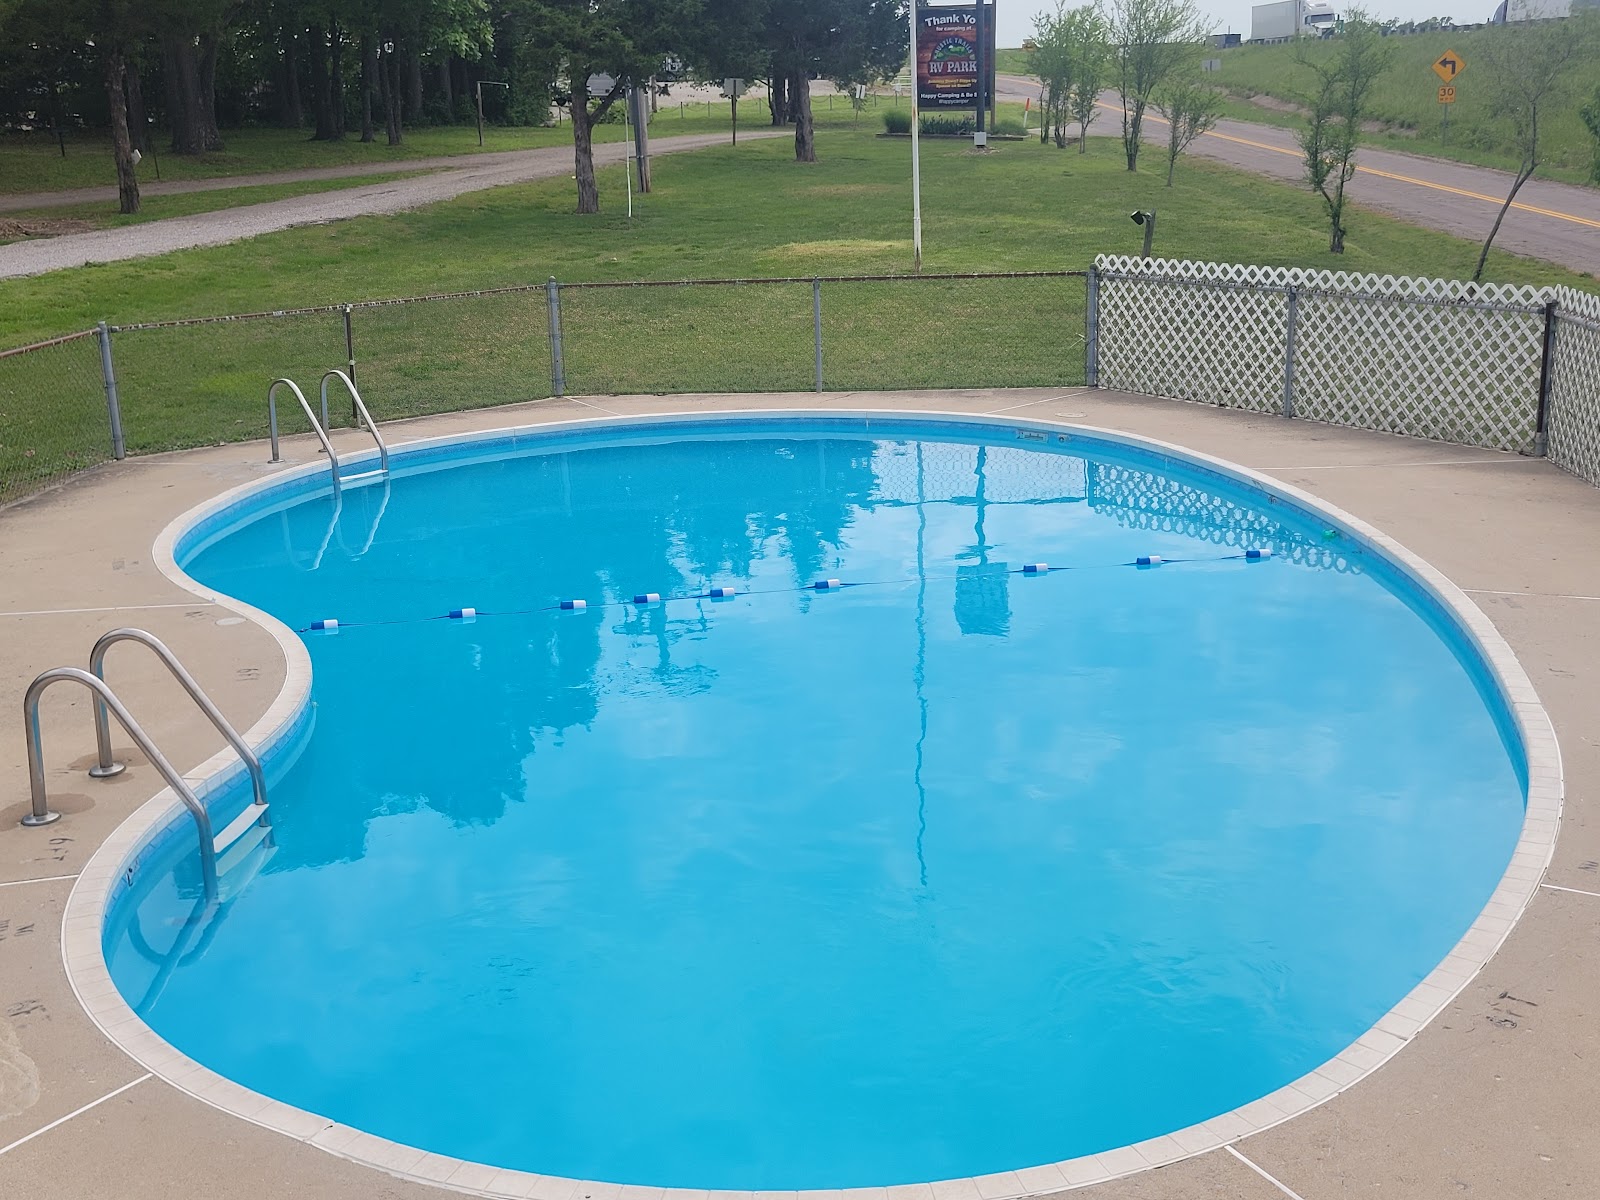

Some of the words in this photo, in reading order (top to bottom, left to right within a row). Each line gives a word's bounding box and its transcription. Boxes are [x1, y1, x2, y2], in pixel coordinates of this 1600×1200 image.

[925, 14, 960, 27] Thank
[962, 14, 976, 24] Yo
[954, 37, 973, 53] TRAILS
[929, 61, 945, 73] RV
[947, 60, 977, 73] PARK
[1440, 88, 1454, 97] 30
